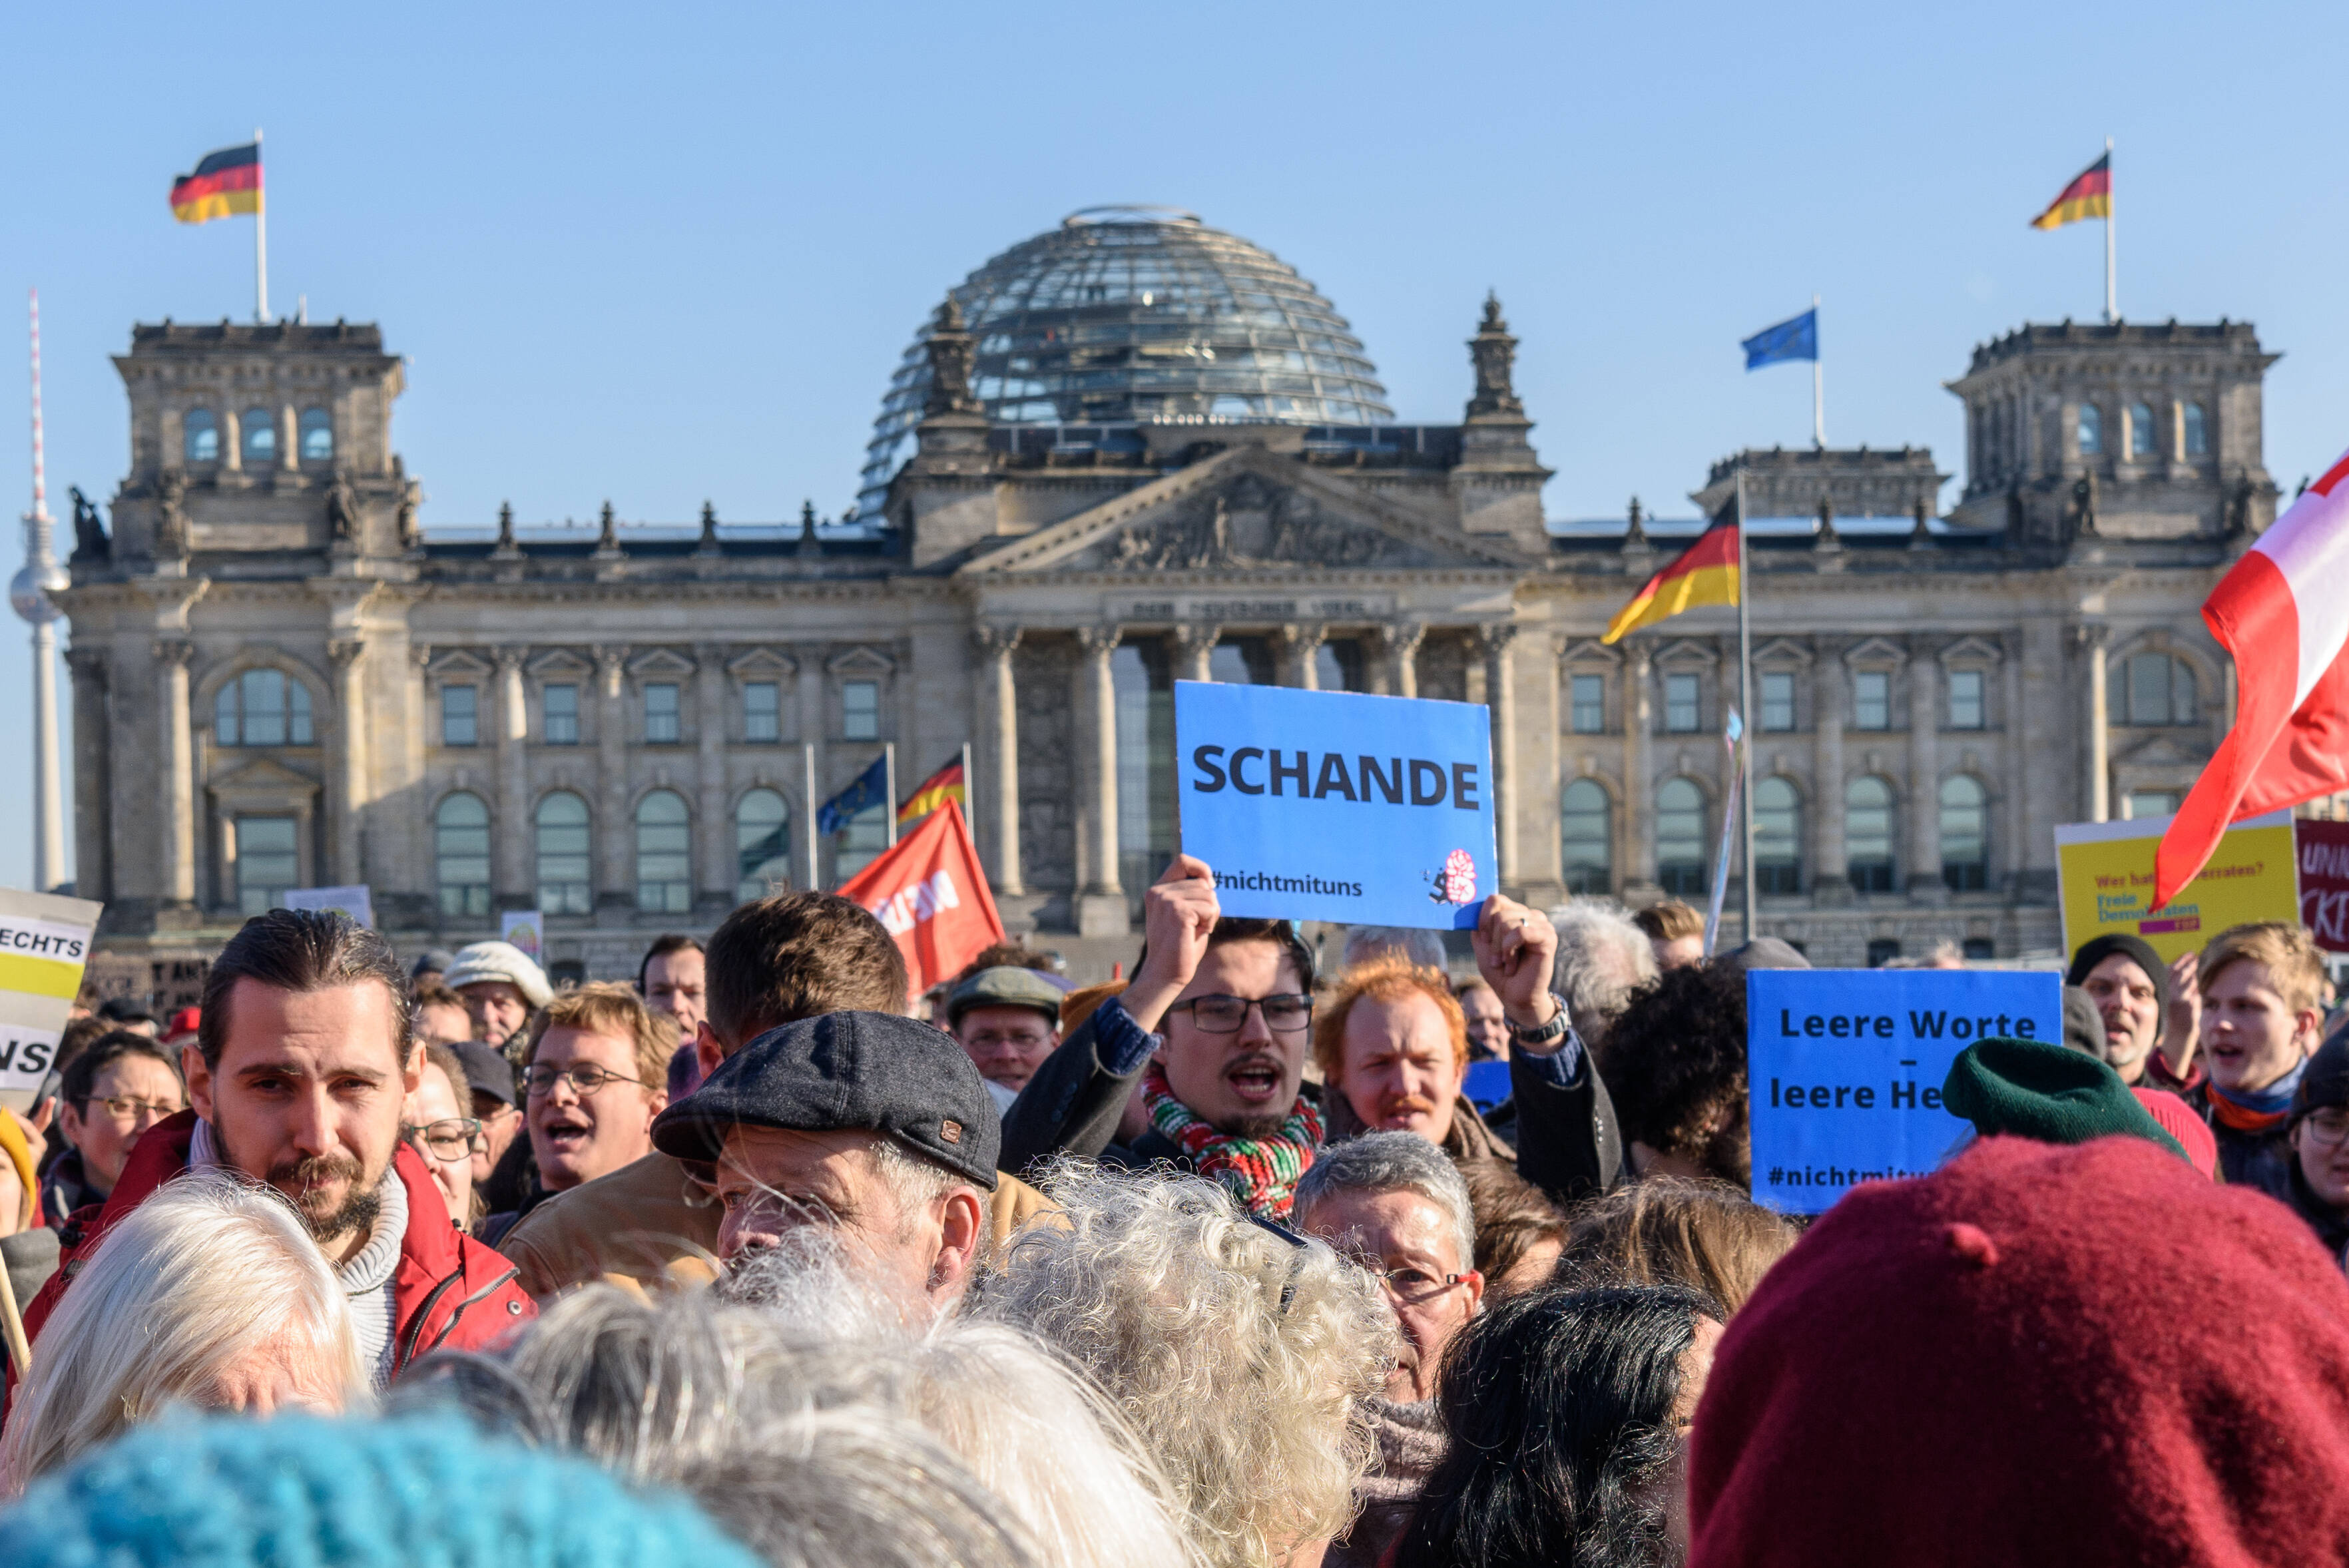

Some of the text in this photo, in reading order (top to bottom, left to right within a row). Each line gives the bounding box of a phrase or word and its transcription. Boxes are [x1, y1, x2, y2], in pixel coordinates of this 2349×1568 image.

[1192, 744, 1480, 811] SCHANDE
[1211, 870, 1363, 897] #nichtmituns
[2195, 860, 2264, 880] erraten?
[0, 928, 84, 957] ECHTS
[1780, 1008, 2037, 1040] Leere Worte
[1770, 1078, 1942, 1109] leere He
[1768, 1166, 1935, 1186] #nichtmit
